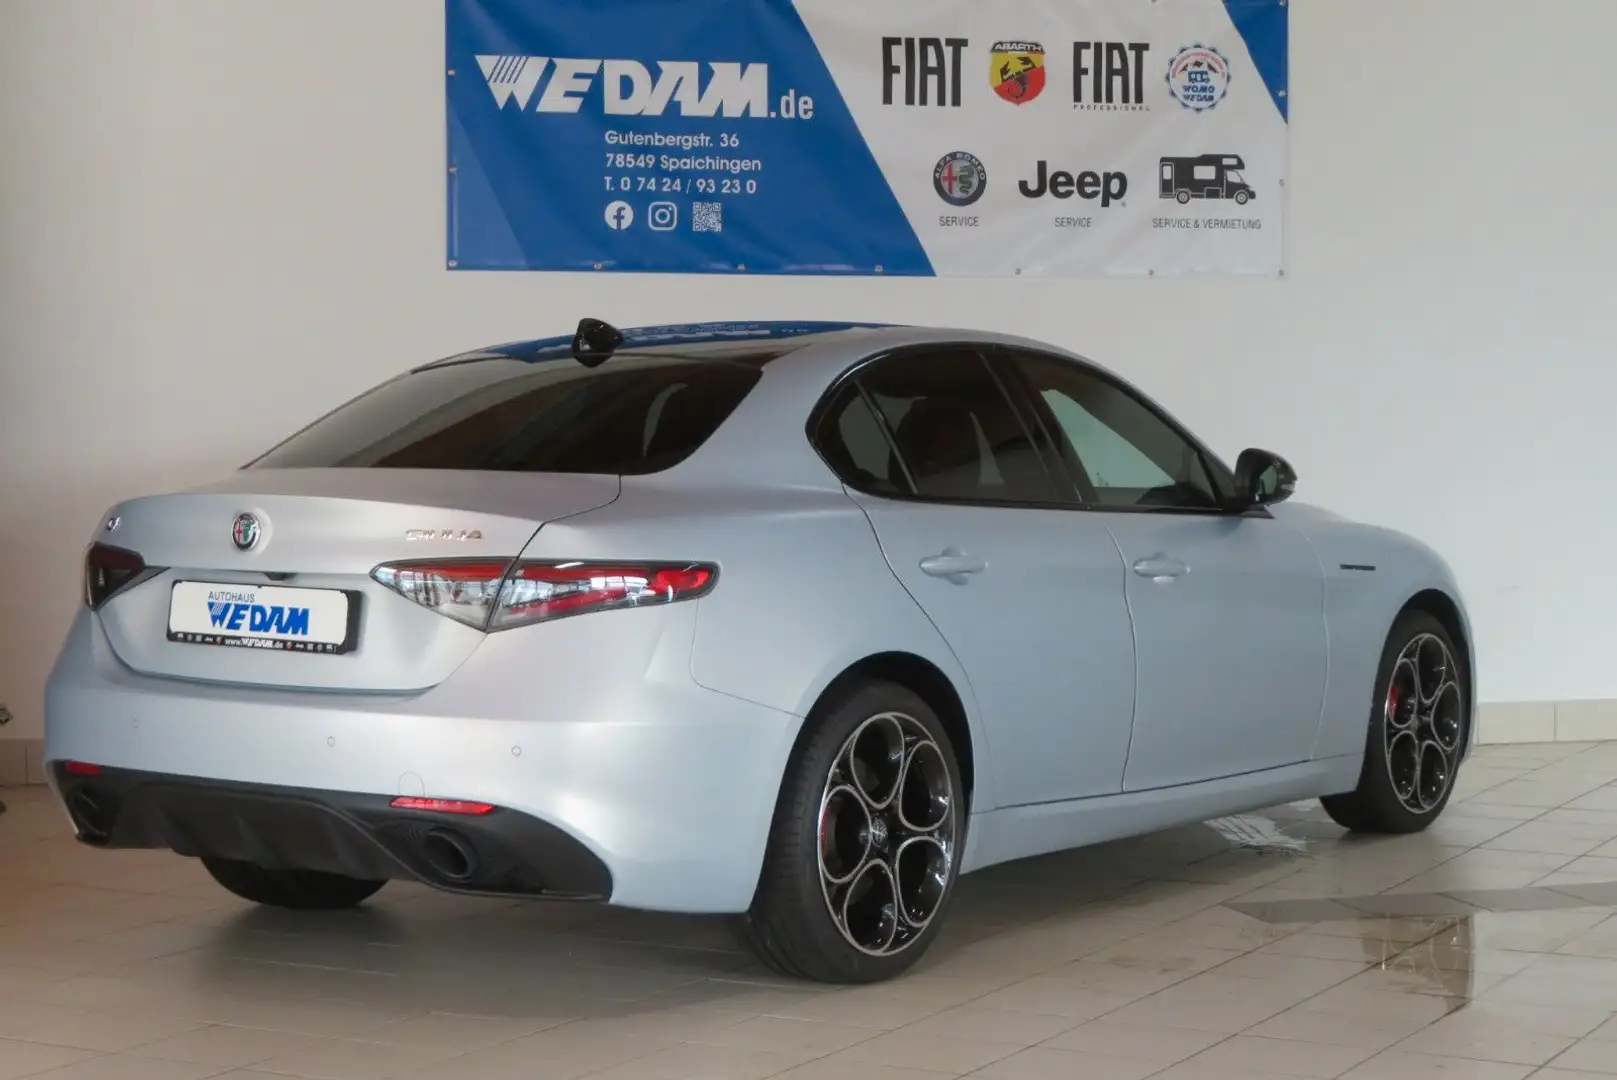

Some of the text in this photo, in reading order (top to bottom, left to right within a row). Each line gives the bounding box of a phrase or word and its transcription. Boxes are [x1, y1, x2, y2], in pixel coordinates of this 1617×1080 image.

[994, 42, 1044, 52] ABARTH
[881, 36, 969, 108] FIAT
[1073, 41, 1150, 104] FIAT
[1182, 85, 1215, 94] WOMO
[1073, 104, 1151, 112] PROFESSIONAL
[604, 130, 740, 150] Gutenbergstr. 36
[605, 153, 762, 174] 78549 Spaichingen
[935, 152, 986, 180] ALFA ROMEO
[604, 176, 757, 194] T. 0 74 24 / 93 23 0
[1018, 160, 1128, 208] Jeep
[939, 215, 979, 227] SERVICE
[1054, 217, 1092, 228] SERVICE
[1152, 218, 1261, 230] SERVICE & VERMIETUNG
[208, 591, 255, 603] AUTOHAUS
[207, 601, 310, 636] WEDAM
